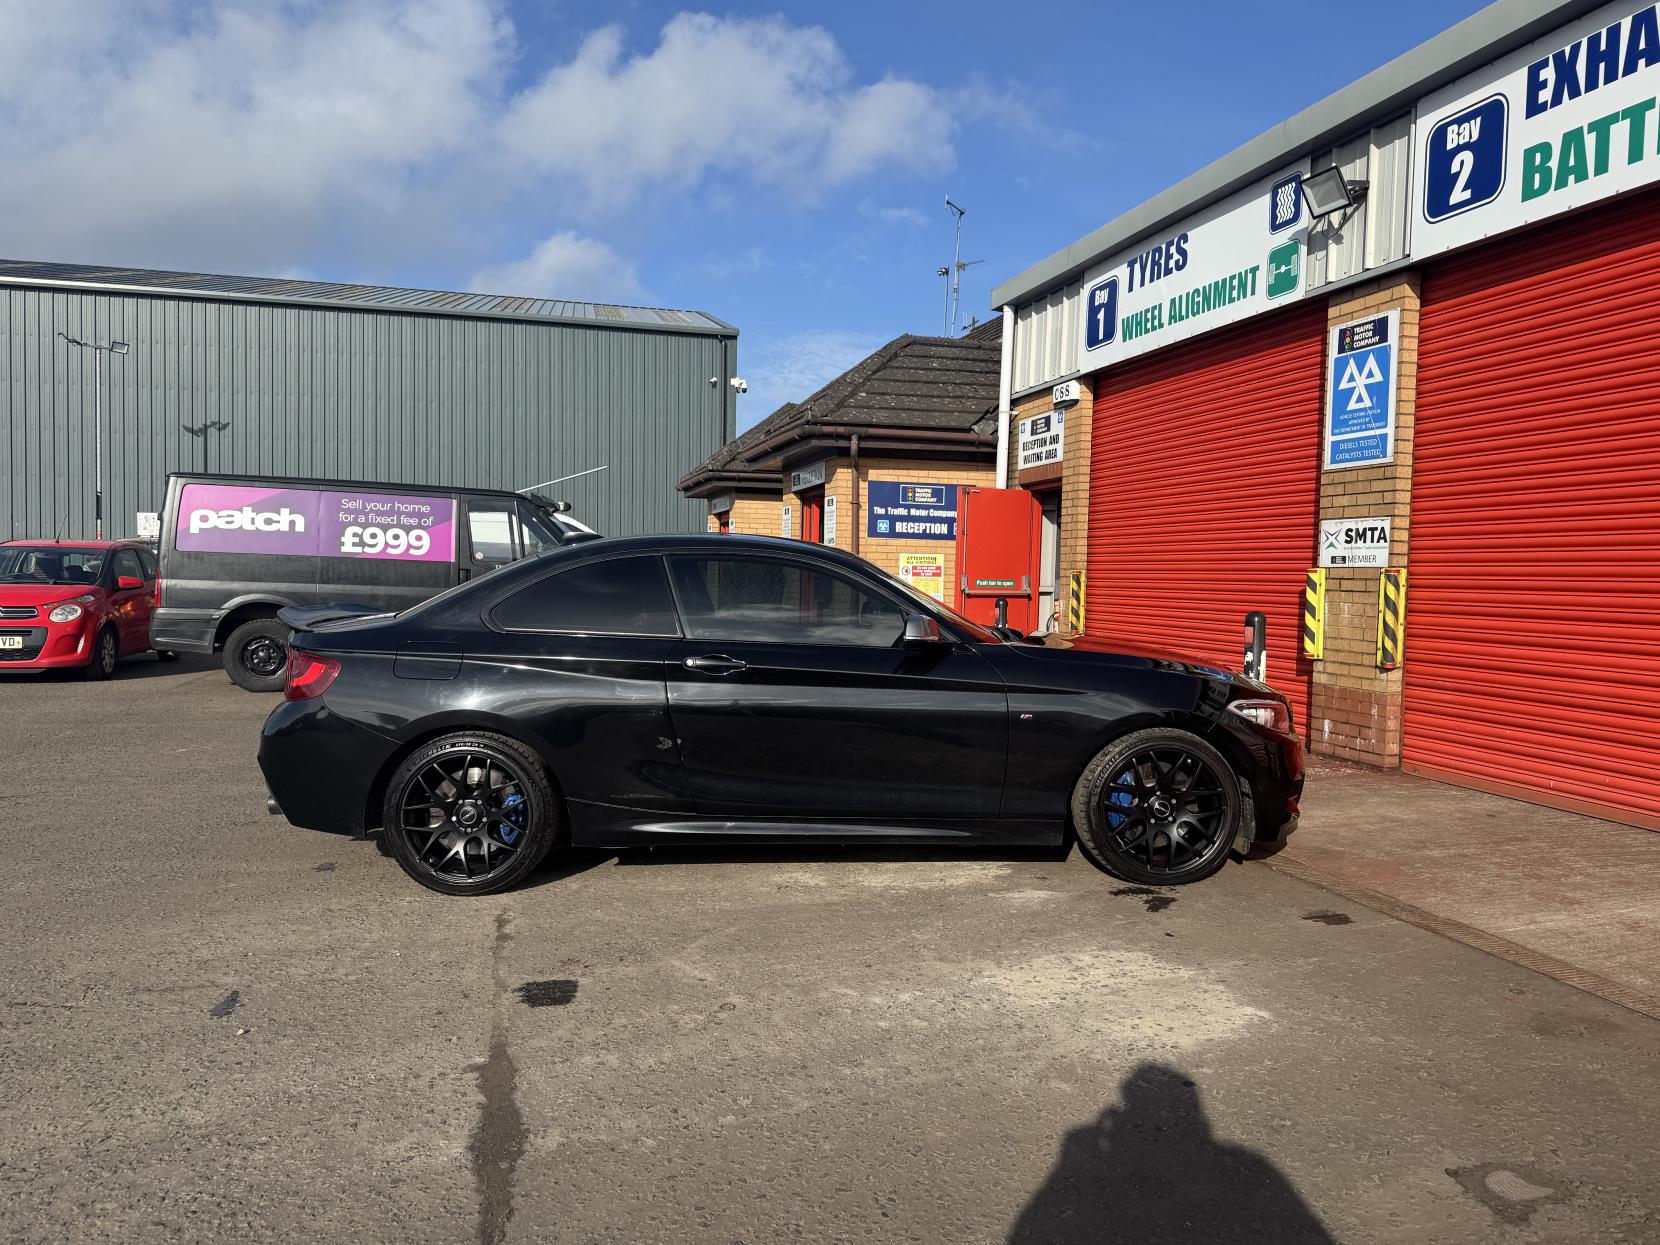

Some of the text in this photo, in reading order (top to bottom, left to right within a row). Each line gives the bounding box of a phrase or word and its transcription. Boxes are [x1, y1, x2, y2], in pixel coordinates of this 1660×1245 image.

[1446, 116, 1481, 150] Bay
[1521, 96, 1660, 203] BATT
[1449, 150, 1474, 206] 2
[1127, 232, 1189, 293] TYRES
[1094, 287, 1109, 306] Bay
[1122, 265, 1260, 342] WHEEL ALIGNMENT
[1097, 307, 1105, 340] 1
[1354, 323, 1374, 334] TRAFFIC
[1354, 331, 1373, 341] MOTOR
[1354, 336, 1379, 348] COMPANY
[1022, 433, 1060, 452] RECEPTION AND
[1340, 442, 1358, 450] DIESELS
[1044, 448, 1058, 460] AREA
[1336, 449, 1380, 460] CATALYSTS TESTED
[341, 498, 430, 513] Sell your home
[888, 507, 908, 515] Traffic
[910, 508, 929, 516] Motor
[189, 506, 305, 533] patch
[339, 512, 355, 522] for
[368, 513, 397, 524] fixed
[400, 515, 418, 526] fee
[421, 517, 434, 526] of
[895, 522, 947, 534] RECEPTION
[1344, 526, 1388, 544] SMTA
[341, 526, 431, 555] £999
[1348, 554, 1377, 563] MEMBER
